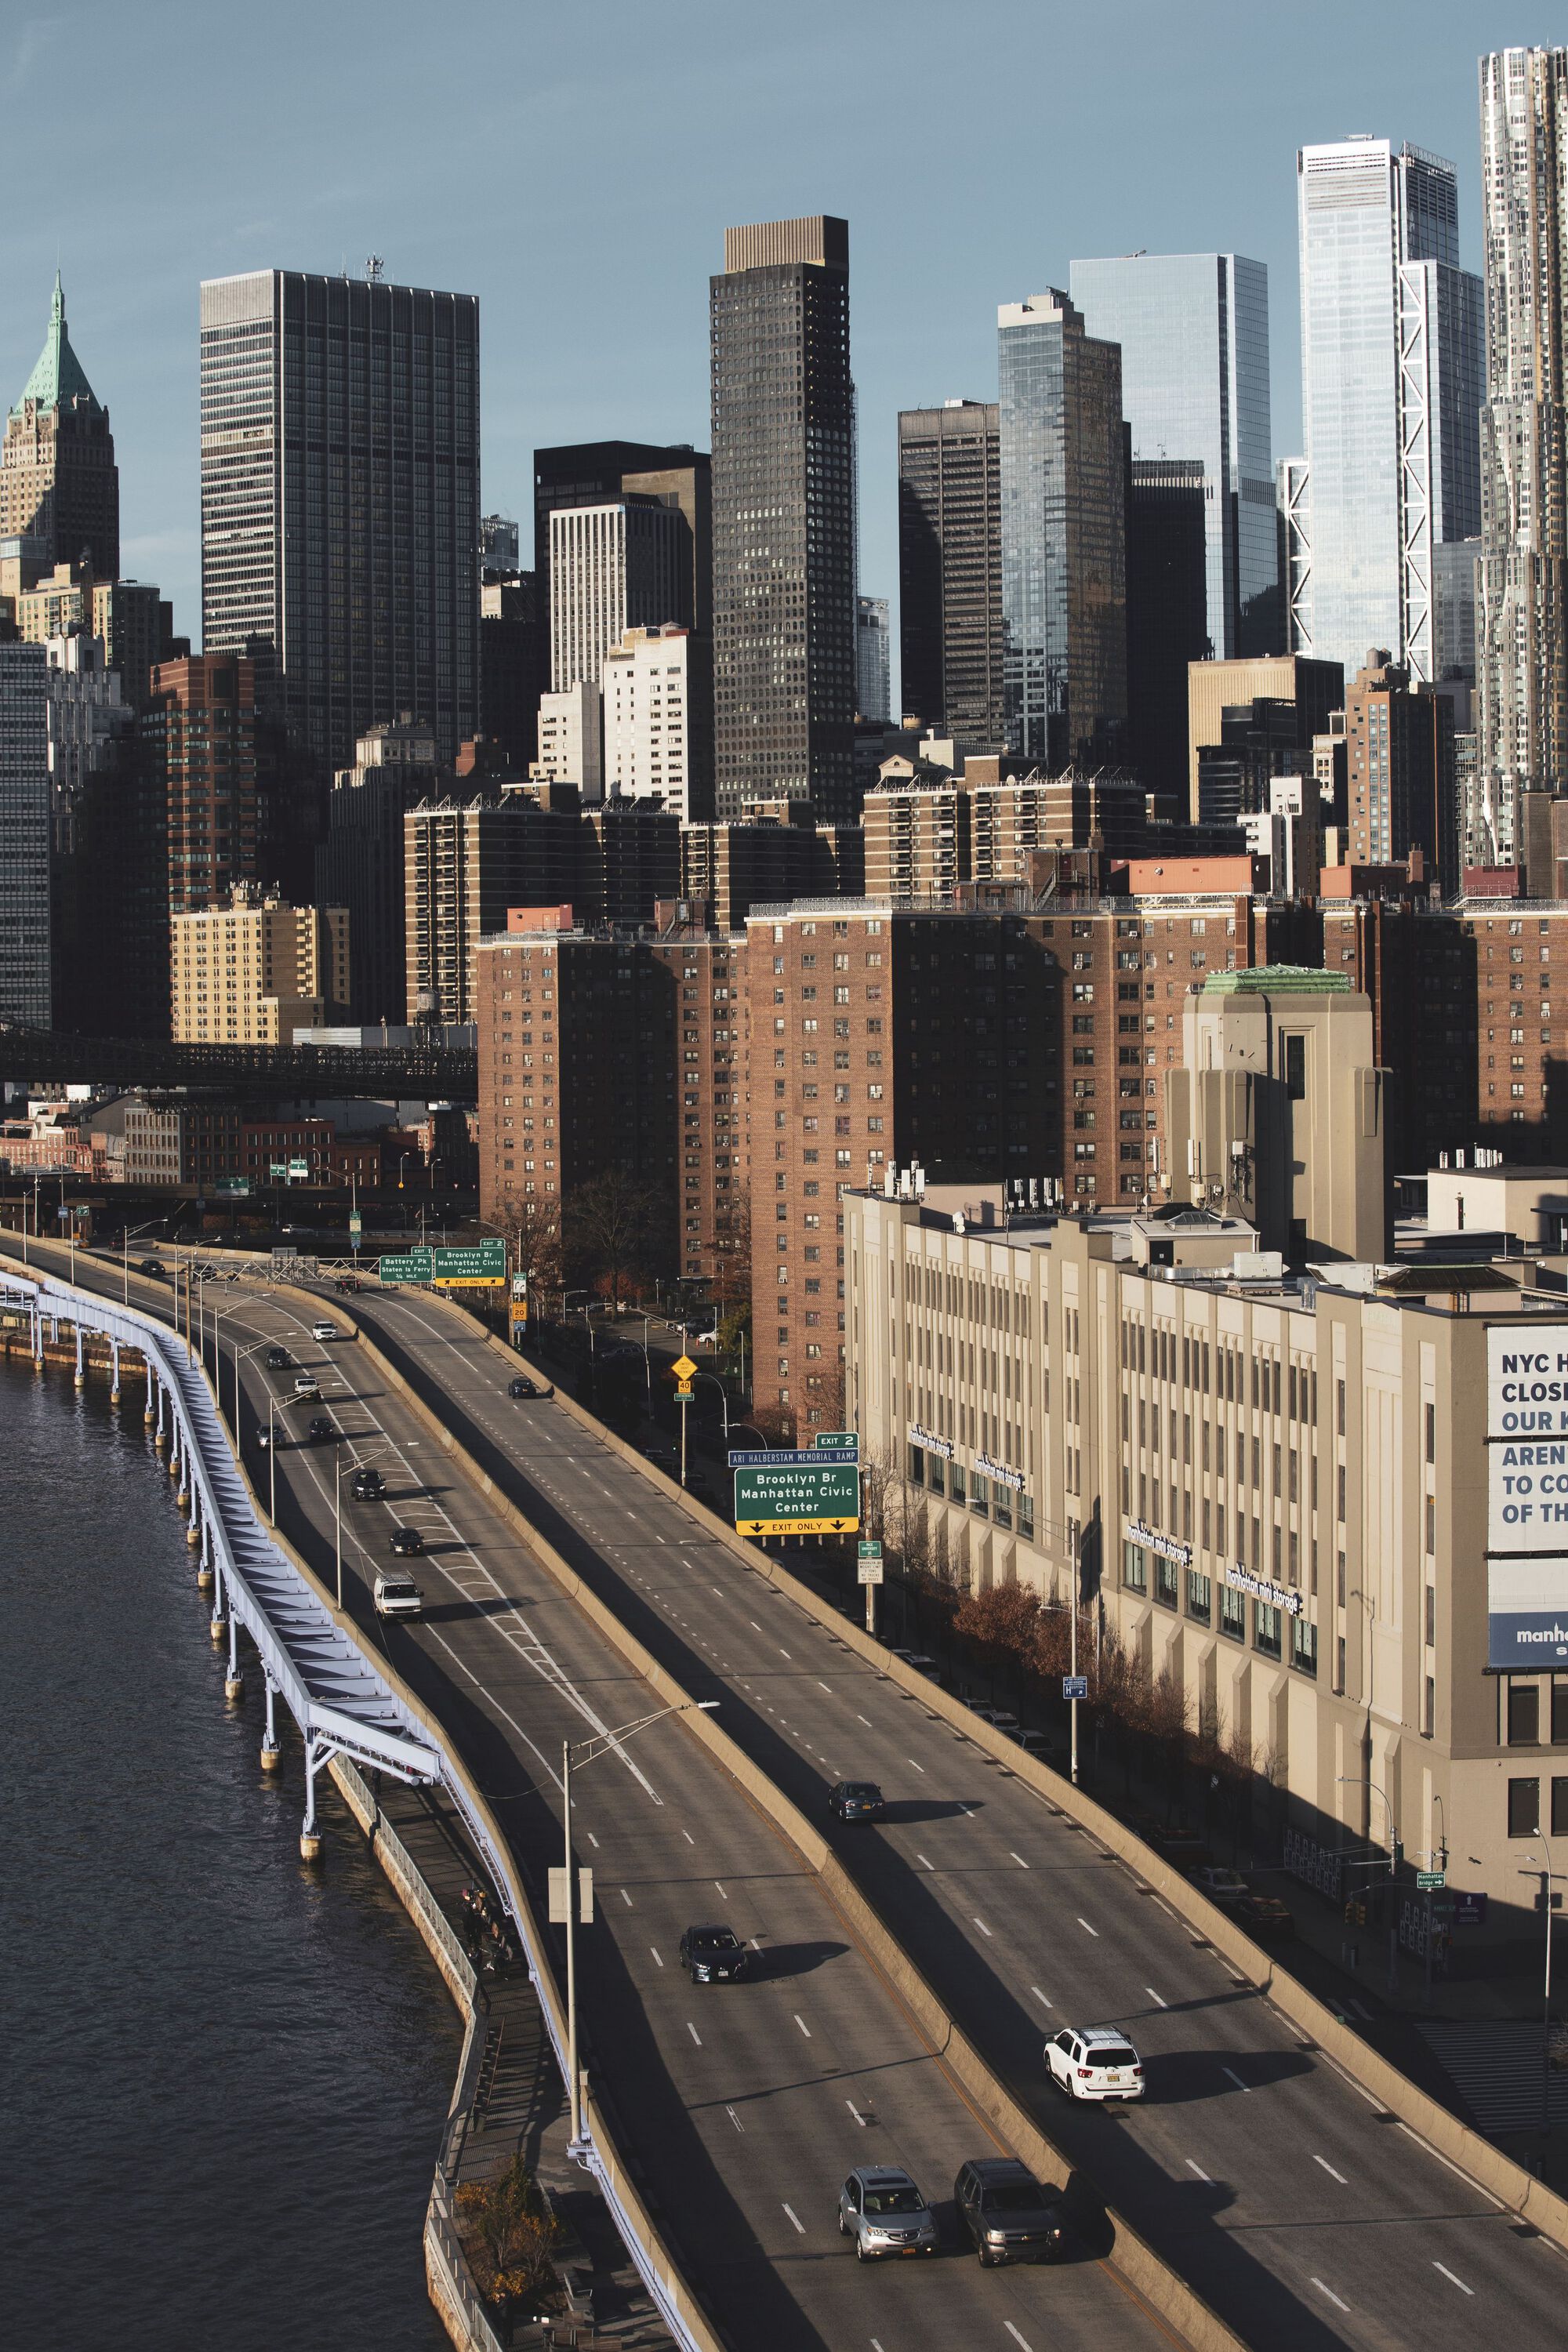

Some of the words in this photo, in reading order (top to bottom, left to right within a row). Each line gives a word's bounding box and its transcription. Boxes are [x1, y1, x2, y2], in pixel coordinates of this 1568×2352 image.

[1502, 1353, 1550, 1374] NYC
[1501, 1411, 1552, 1432] OUR
[844, 1436, 854, 1446] 2
[733, 1454, 745, 1463] ARI
[749, 1454, 793, 1463] HALBERSTAM
[798, 1453, 832, 1461] MEMORIAL
[837, 1452, 855, 1461] RAMP
[1501, 1445, 1568, 1466] AREN
[757, 1473, 815, 1485] Brooklyn
[822, 1472, 837, 1483] Br
[1502, 1475, 1533, 1495] TO
[741, 1488, 813, 1499] Manhattan
[819, 1486, 853, 1497] Civic
[775, 1502, 819, 1512] Center
[1502, 1504, 1533, 1524] OF
[1127, 1519, 1155, 1548] manhattan
[1155, 1537, 1167, 1553] mini
[1167, 1542, 1188, 1566] storage
[1226, 1563, 1258, 1595] manhattan
[1259, 1582, 1272, 1600] mini
[1272, 1588, 1298, 1615] storage
[1065, 1686, 1084, 1695] HOSPITAL
